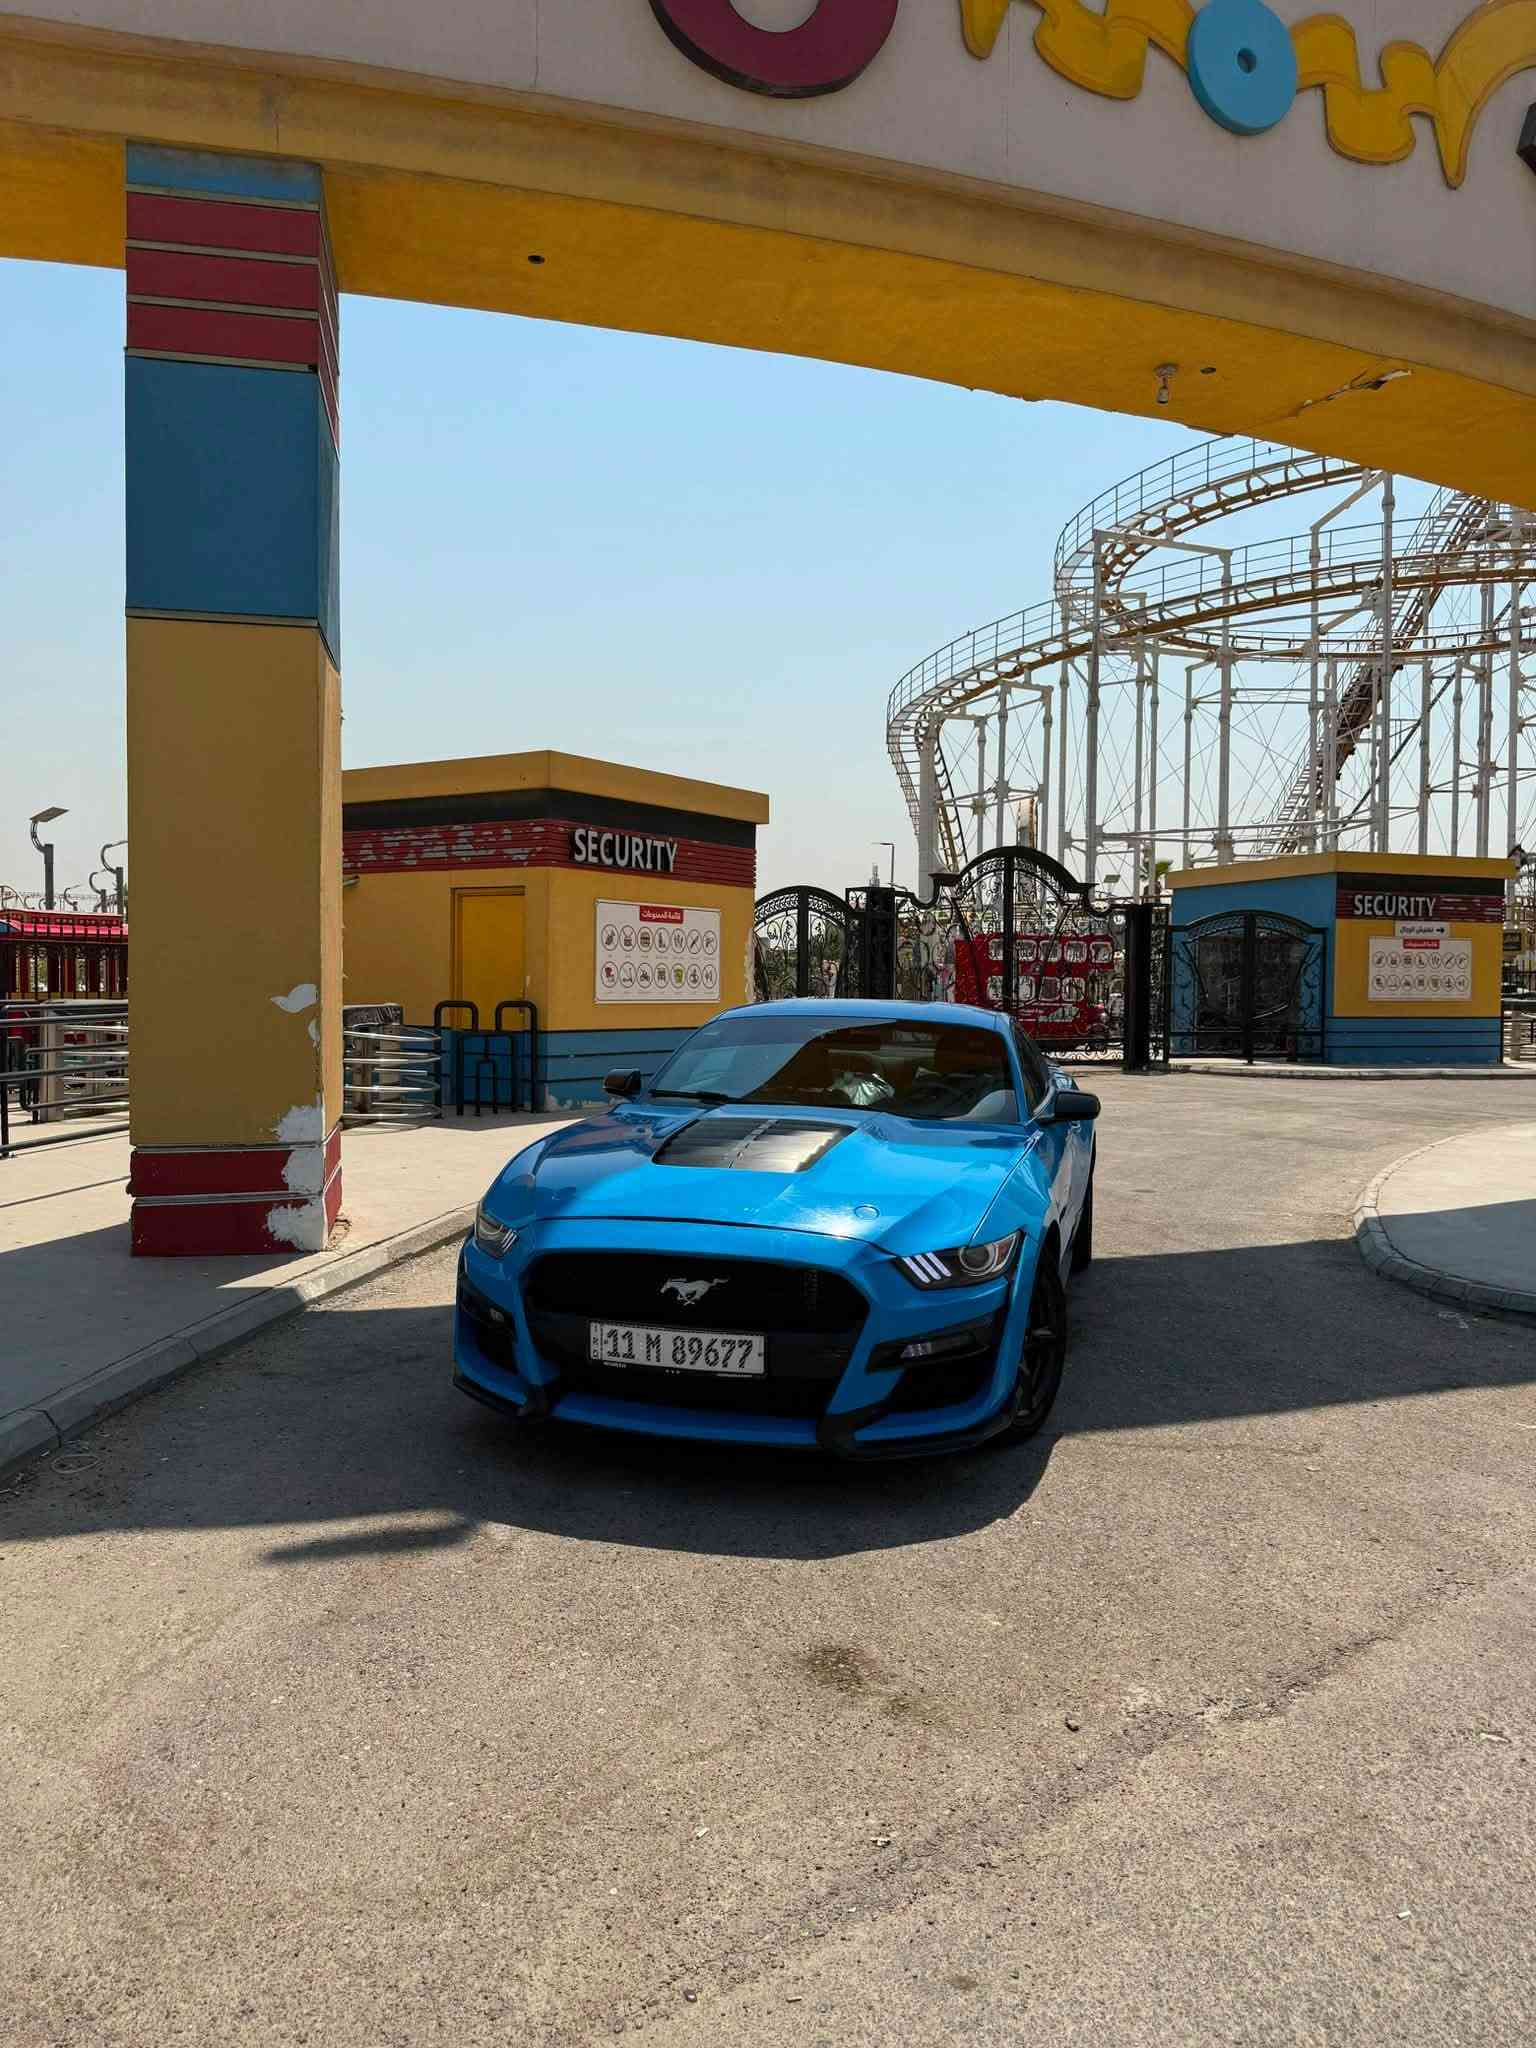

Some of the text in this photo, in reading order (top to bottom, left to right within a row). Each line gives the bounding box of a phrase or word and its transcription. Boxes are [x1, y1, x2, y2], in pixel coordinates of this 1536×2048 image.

[574, 828, 679, 872] SECURITY
[1353, 895, 1437, 917] SECURITY
[607, 1329, 753, 1369] 11 M 89677
